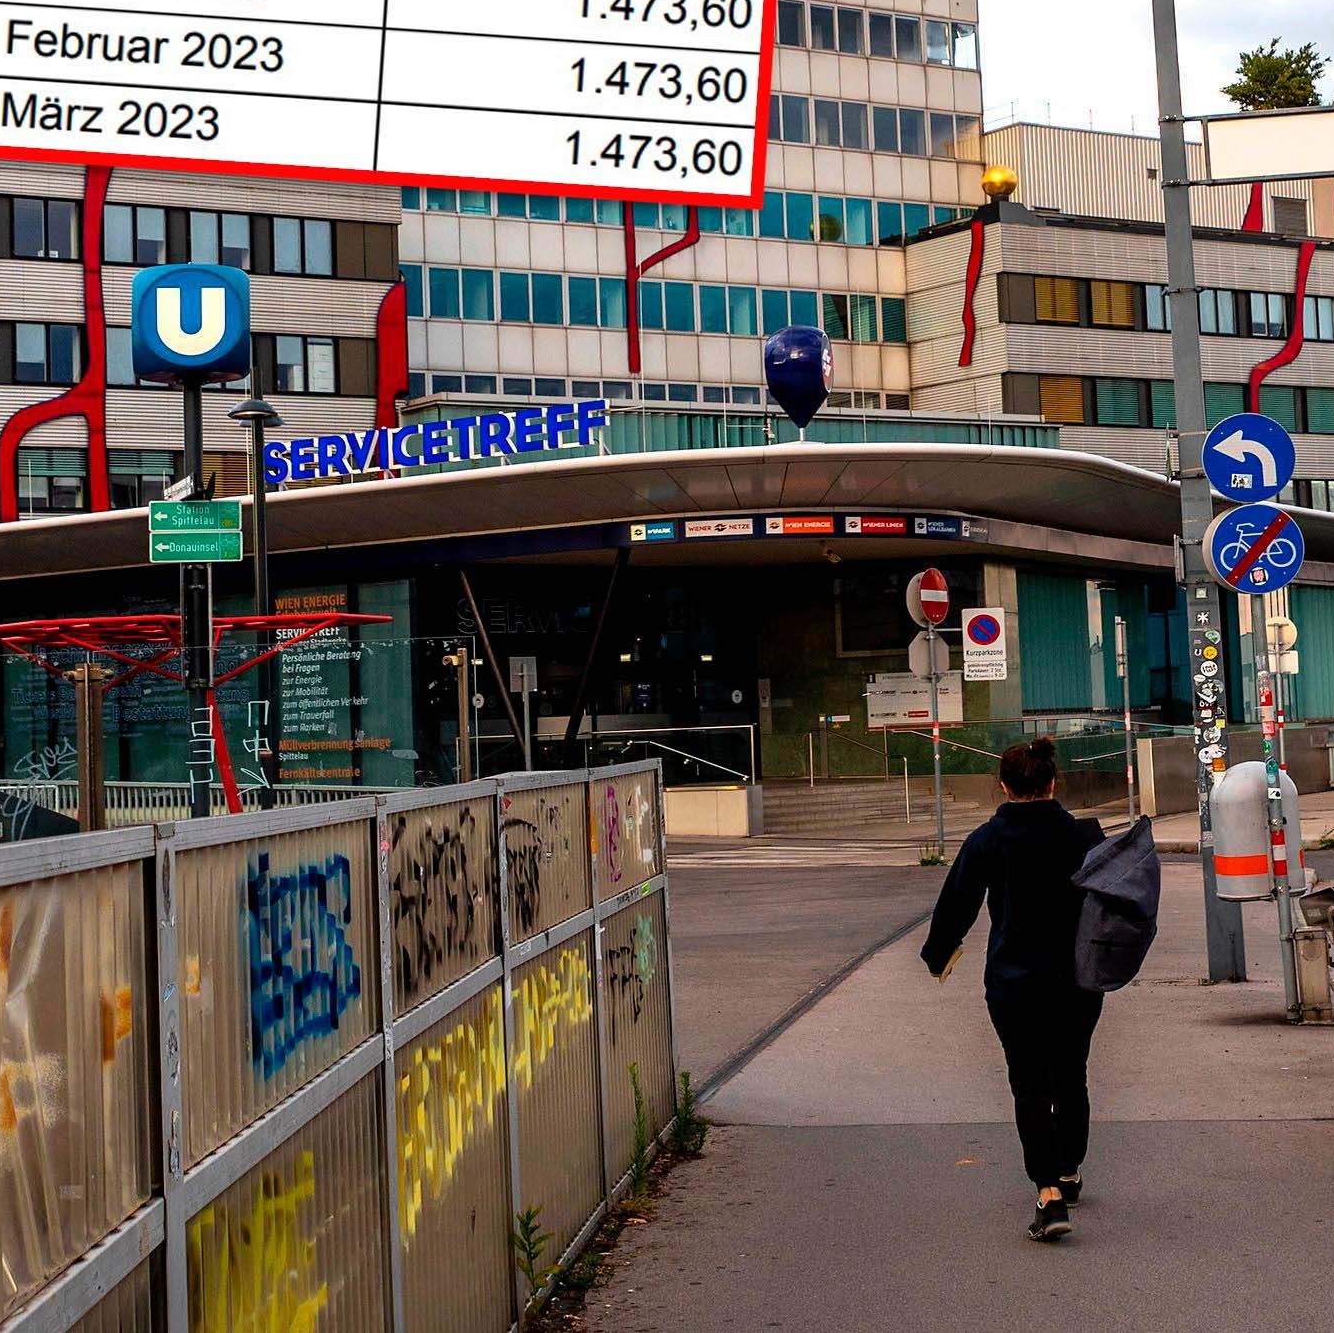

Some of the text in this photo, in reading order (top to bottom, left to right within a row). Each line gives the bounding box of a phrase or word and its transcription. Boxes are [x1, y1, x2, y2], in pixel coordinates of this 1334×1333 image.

[156, 287, 226, 356] U
[264, 399, 610, 484] SERVICETREFF
[176, 504, 210, 514] Station
[172, 515, 215, 527] Spittelau
[169, 541, 219, 553] Donauinsel
[275, 594, 347, 609] WIEN ENERGIE
[282, 650, 326, 663] Persönliche
[282, 664, 320, 675] bei Fragen
[282, 675, 323, 686] zur Energie
[282, 686, 329, 697] zur Mobilität
[282, 701, 297, 709] zum
[299, 698, 340, 710] öffentlichen
[283, 709, 335, 721] zum Trauerfall
[283, 725, 298, 733] zum
[278, 737, 392, 752] Müllverbrennungsanlage
[278, 752, 309, 762] Spittelau
